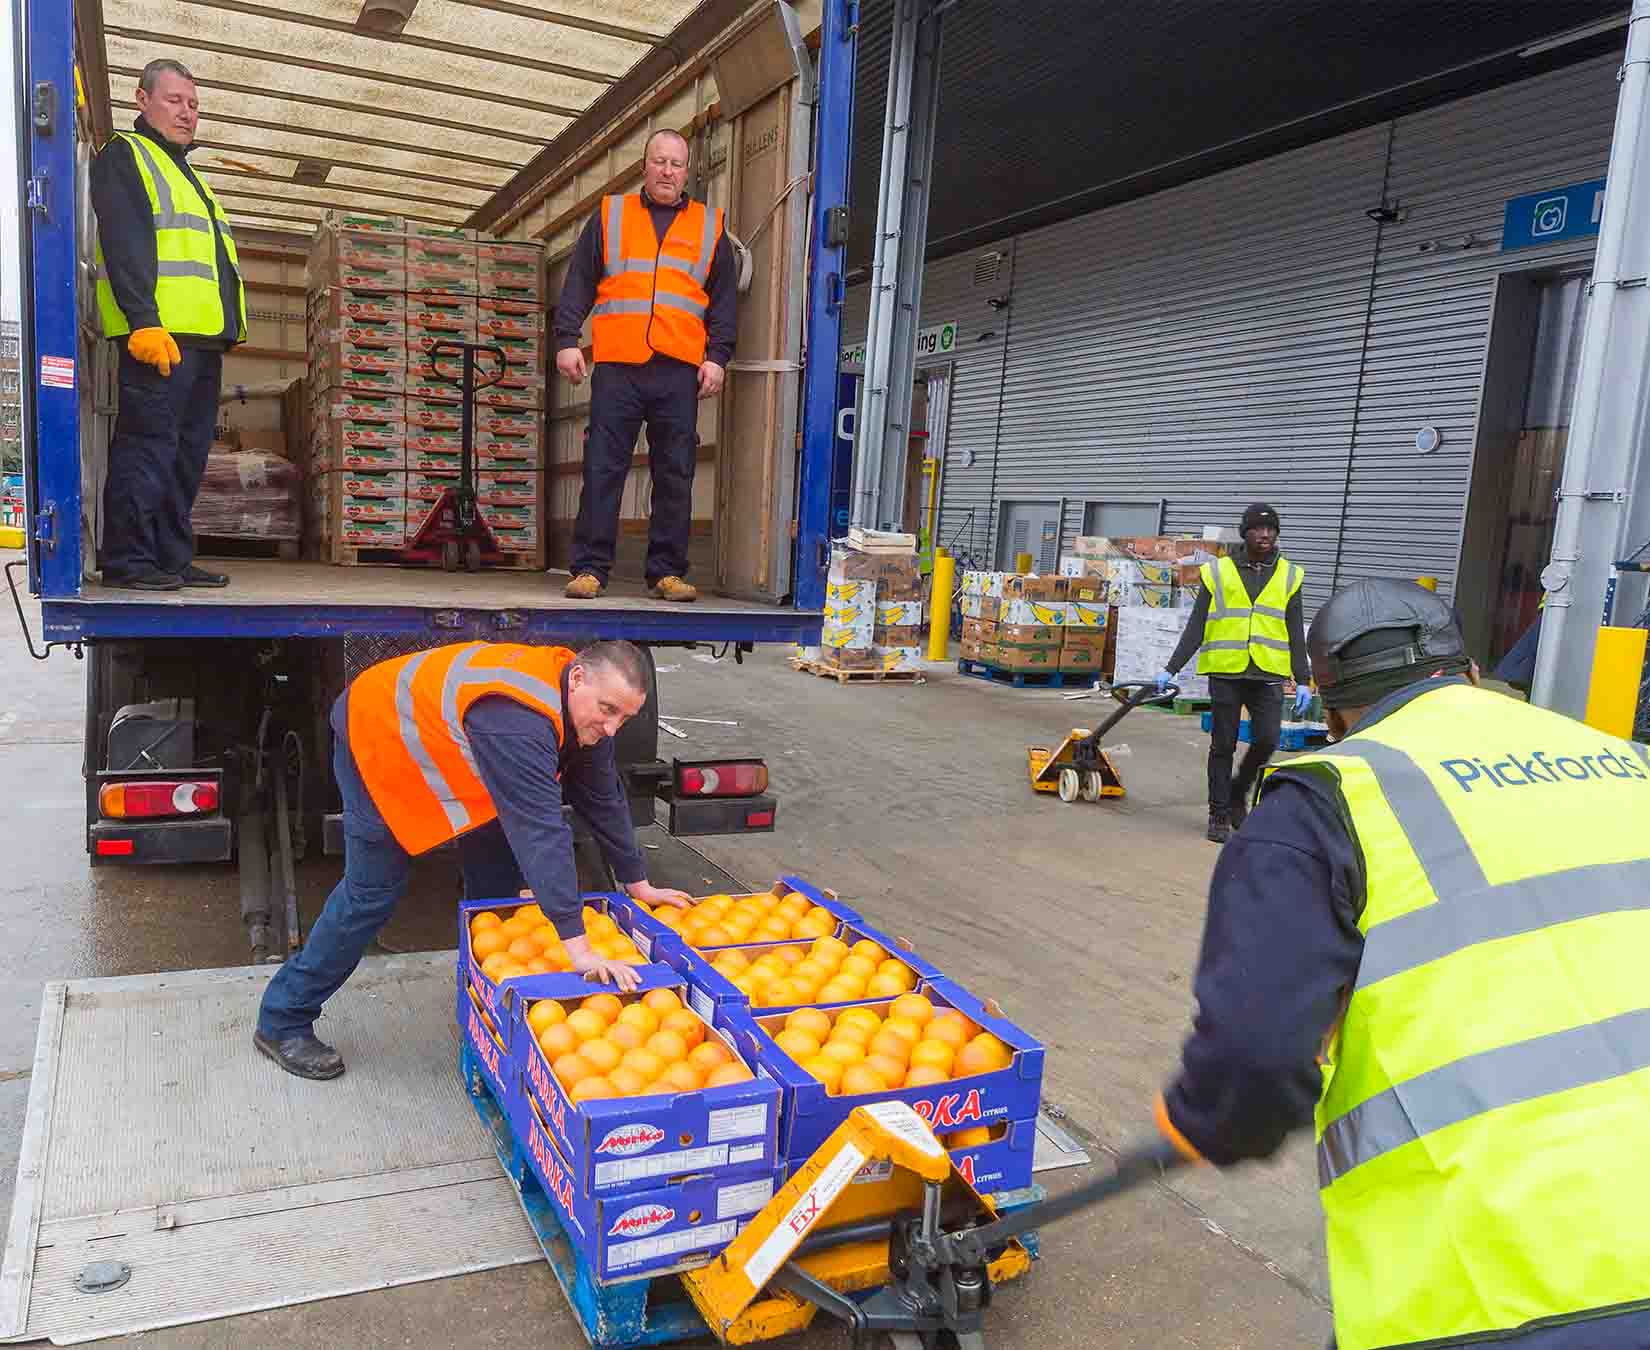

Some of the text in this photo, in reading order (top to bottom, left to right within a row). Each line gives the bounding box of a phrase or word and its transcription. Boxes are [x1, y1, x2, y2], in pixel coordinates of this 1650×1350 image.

[1439, 747, 1648, 793] Pickfords
[527, 1042, 566, 1137] NARKA
[982, 1106, 1009, 1118] CITRUS
[529, 1119, 574, 1219] NARKA
